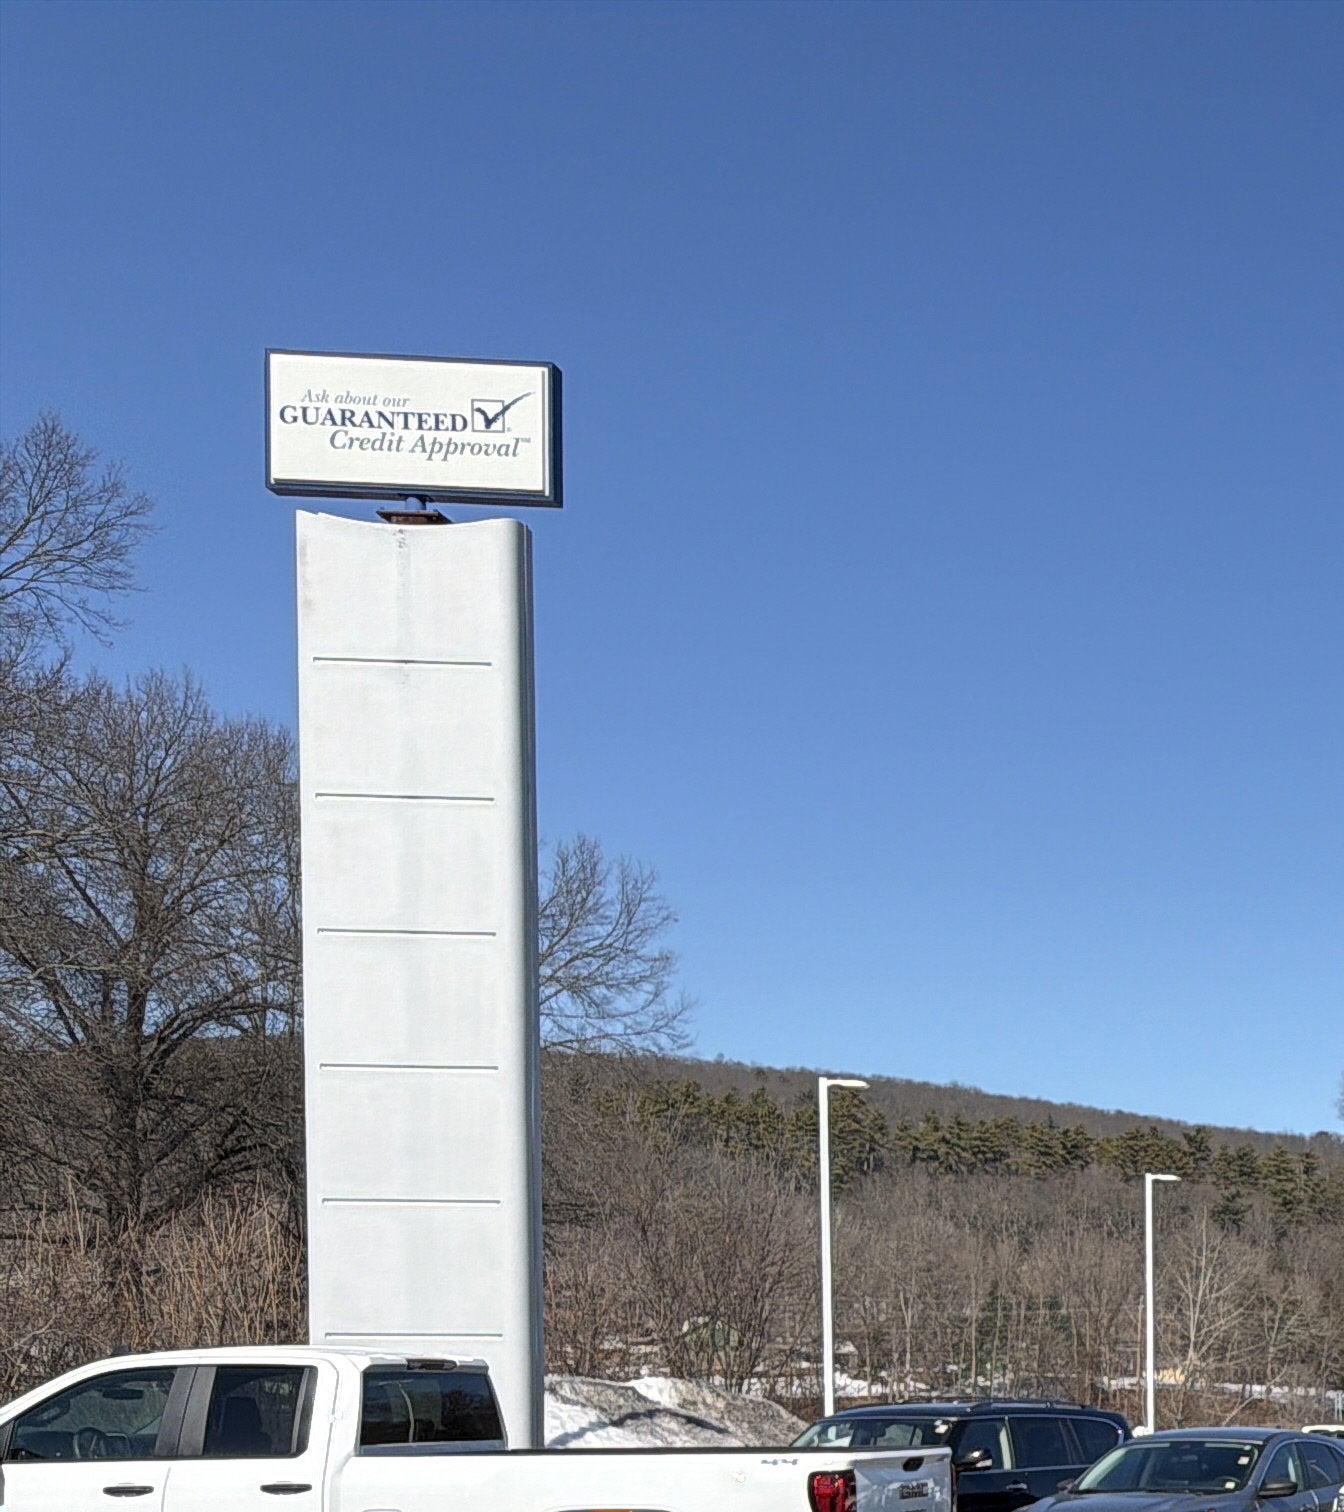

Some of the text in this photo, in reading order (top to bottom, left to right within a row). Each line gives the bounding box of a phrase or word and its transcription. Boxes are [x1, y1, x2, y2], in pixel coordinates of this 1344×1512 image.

[301, 389, 410, 407] Ask about our
[279, 405, 467, 432] GUARANTEED
[329, 430, 404, 452] Credit
